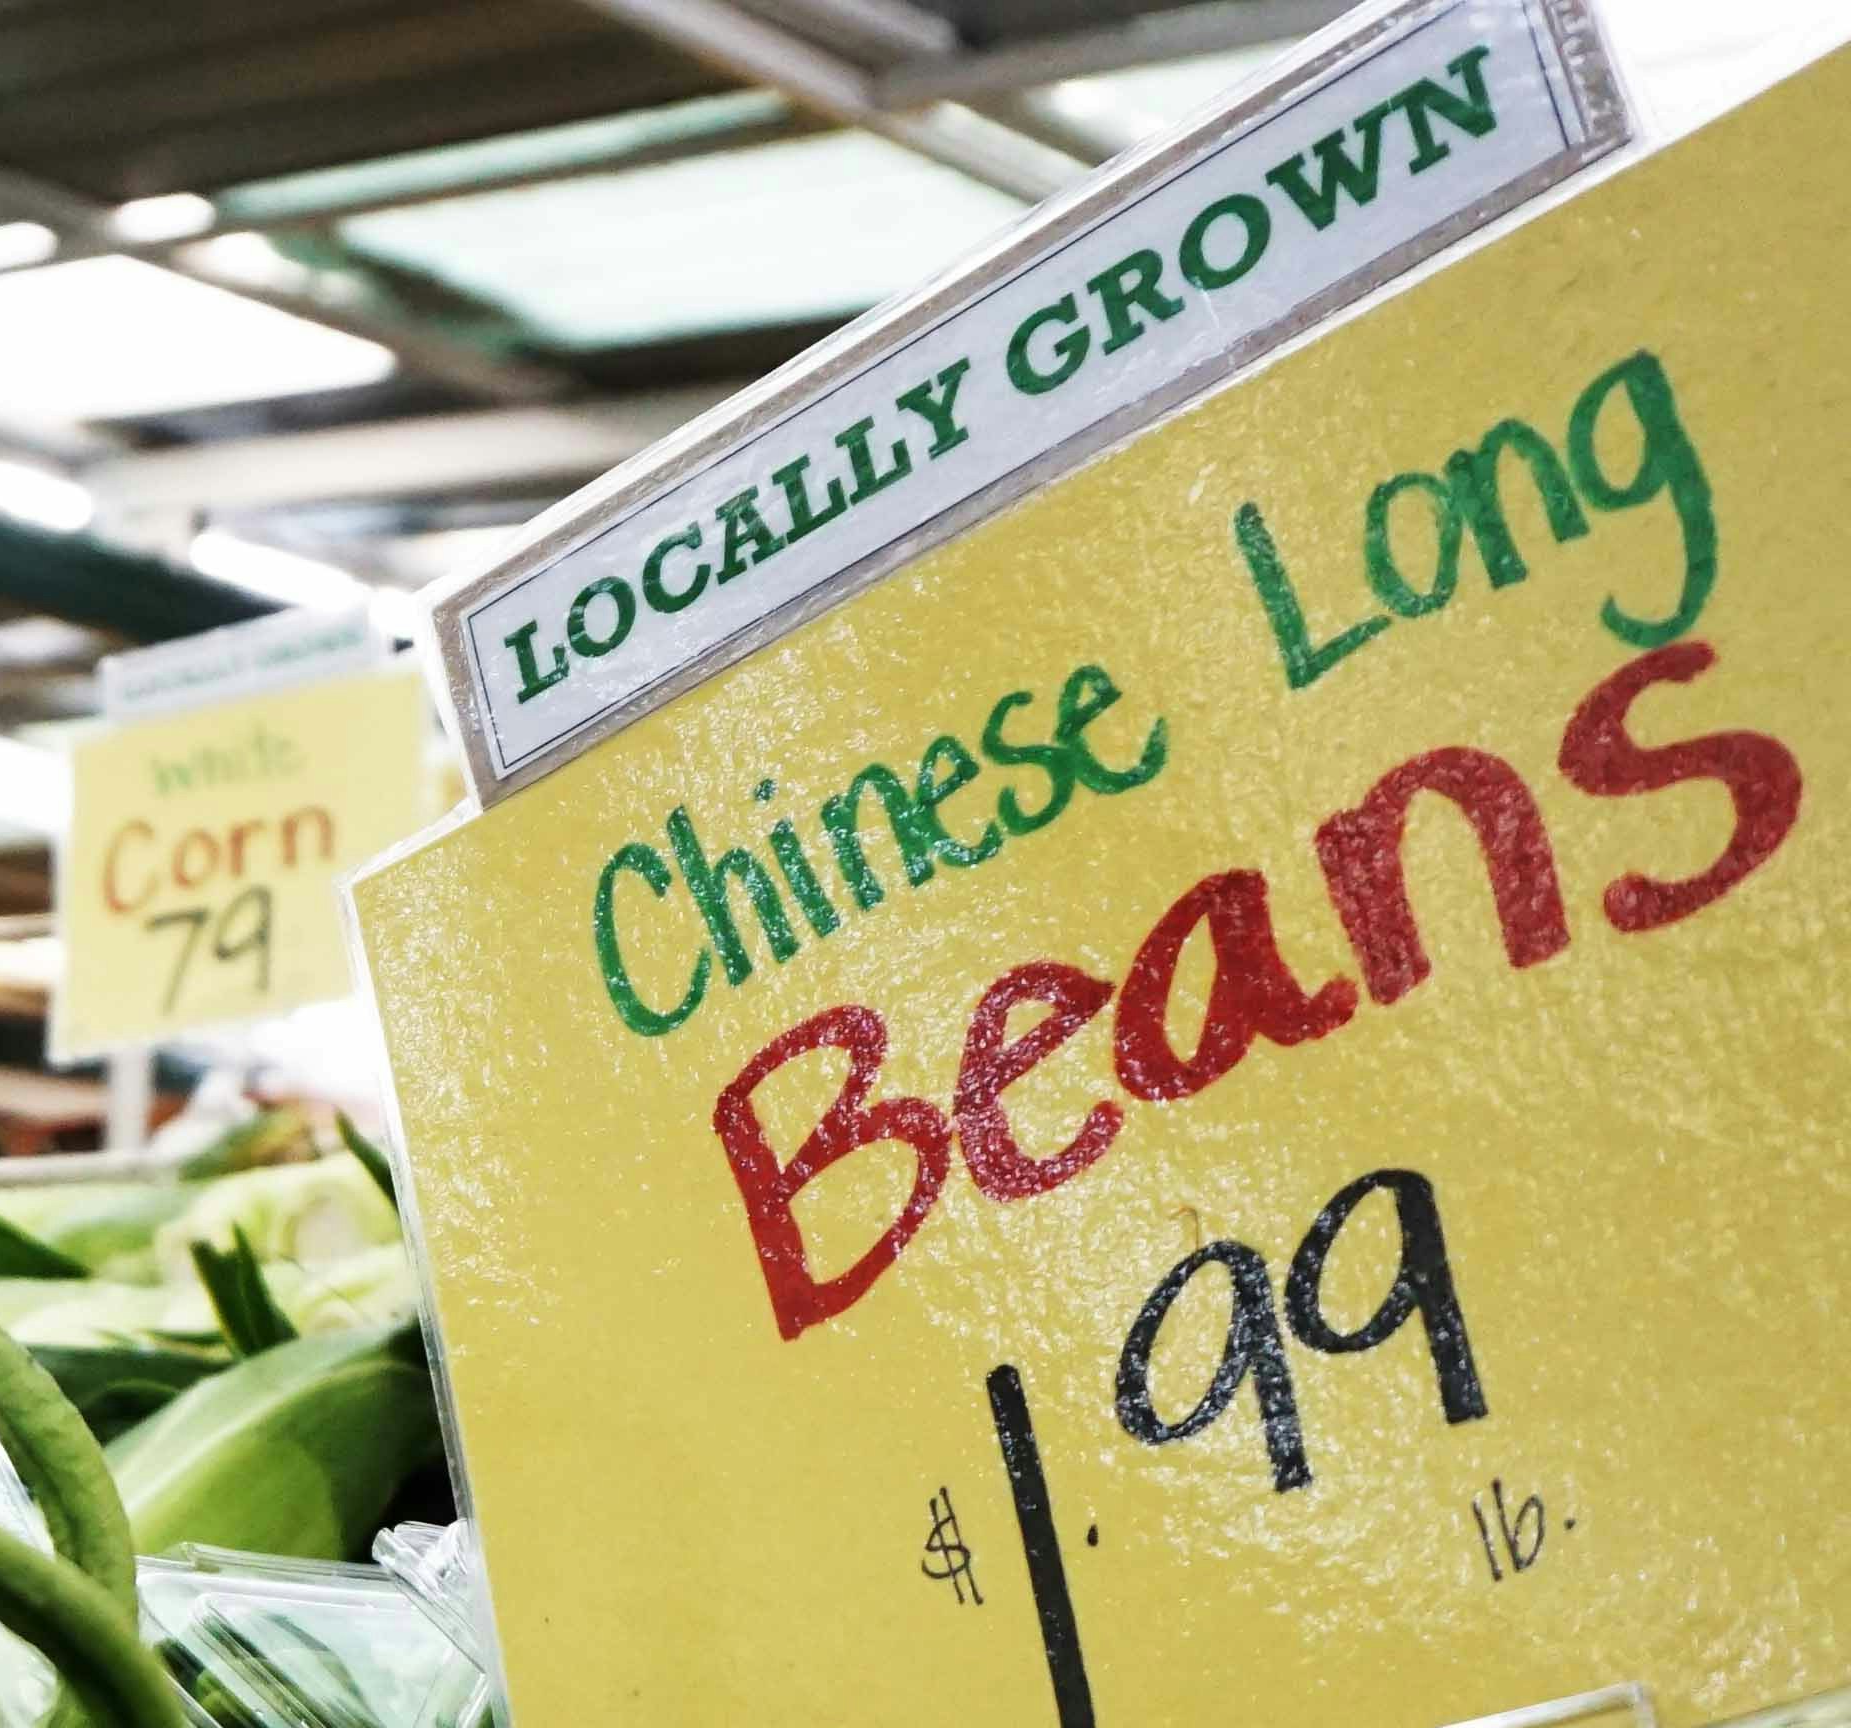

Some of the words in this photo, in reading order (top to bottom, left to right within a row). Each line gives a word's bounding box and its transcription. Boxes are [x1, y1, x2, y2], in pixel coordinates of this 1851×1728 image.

[502, 358, 971, 706] LOCALLY
[1005, 46, 1498, 399] GROWN
[593, 664, 1167, 1037] Chinese
[1232, 350, 1719, 688] Long
[103, 804, 335, 914] Corn
[712, 641, 1802, 1341] Beans
